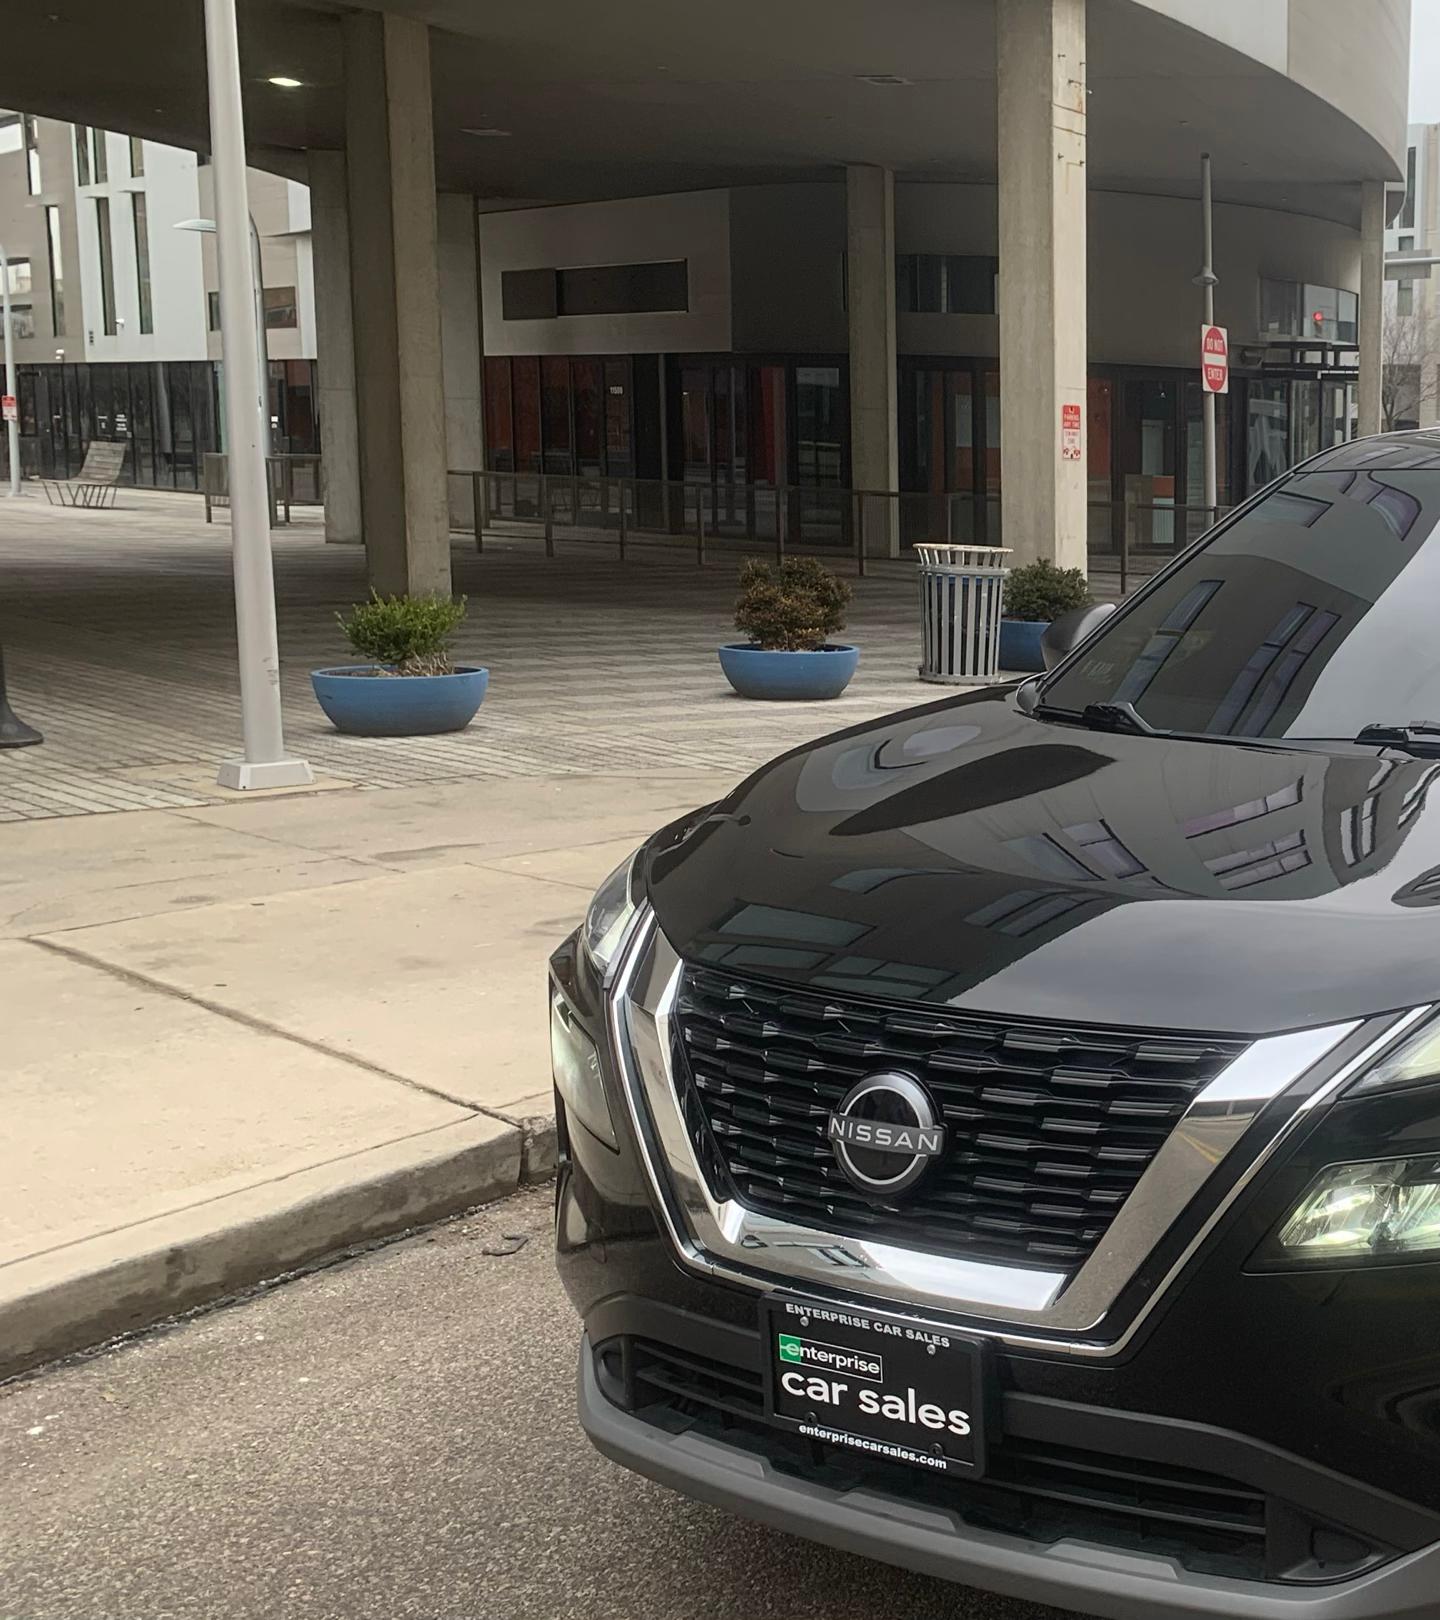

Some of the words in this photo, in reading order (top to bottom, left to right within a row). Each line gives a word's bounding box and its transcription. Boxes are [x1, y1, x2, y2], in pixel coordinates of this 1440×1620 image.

[1206, 338, 1214, 351] DO
[1214, 339, 1224, 353] NOT
[1207, 367, 1223, 381] ENTER
[830, 1117, 938, 1151] NISSAN
[785, 1303, 871, 1330] ENTERPRISE
[873, 1322, 903, 1337] CAR
[905, 1329, 950, 1348] SALES
[784, 1342, 880, 1374] enterprise
[781, 1371, 848, 1406] car
[858, 1387, 971, 1436] sales
[799, 1424, 947, 1470] enterprisecarsales.com
